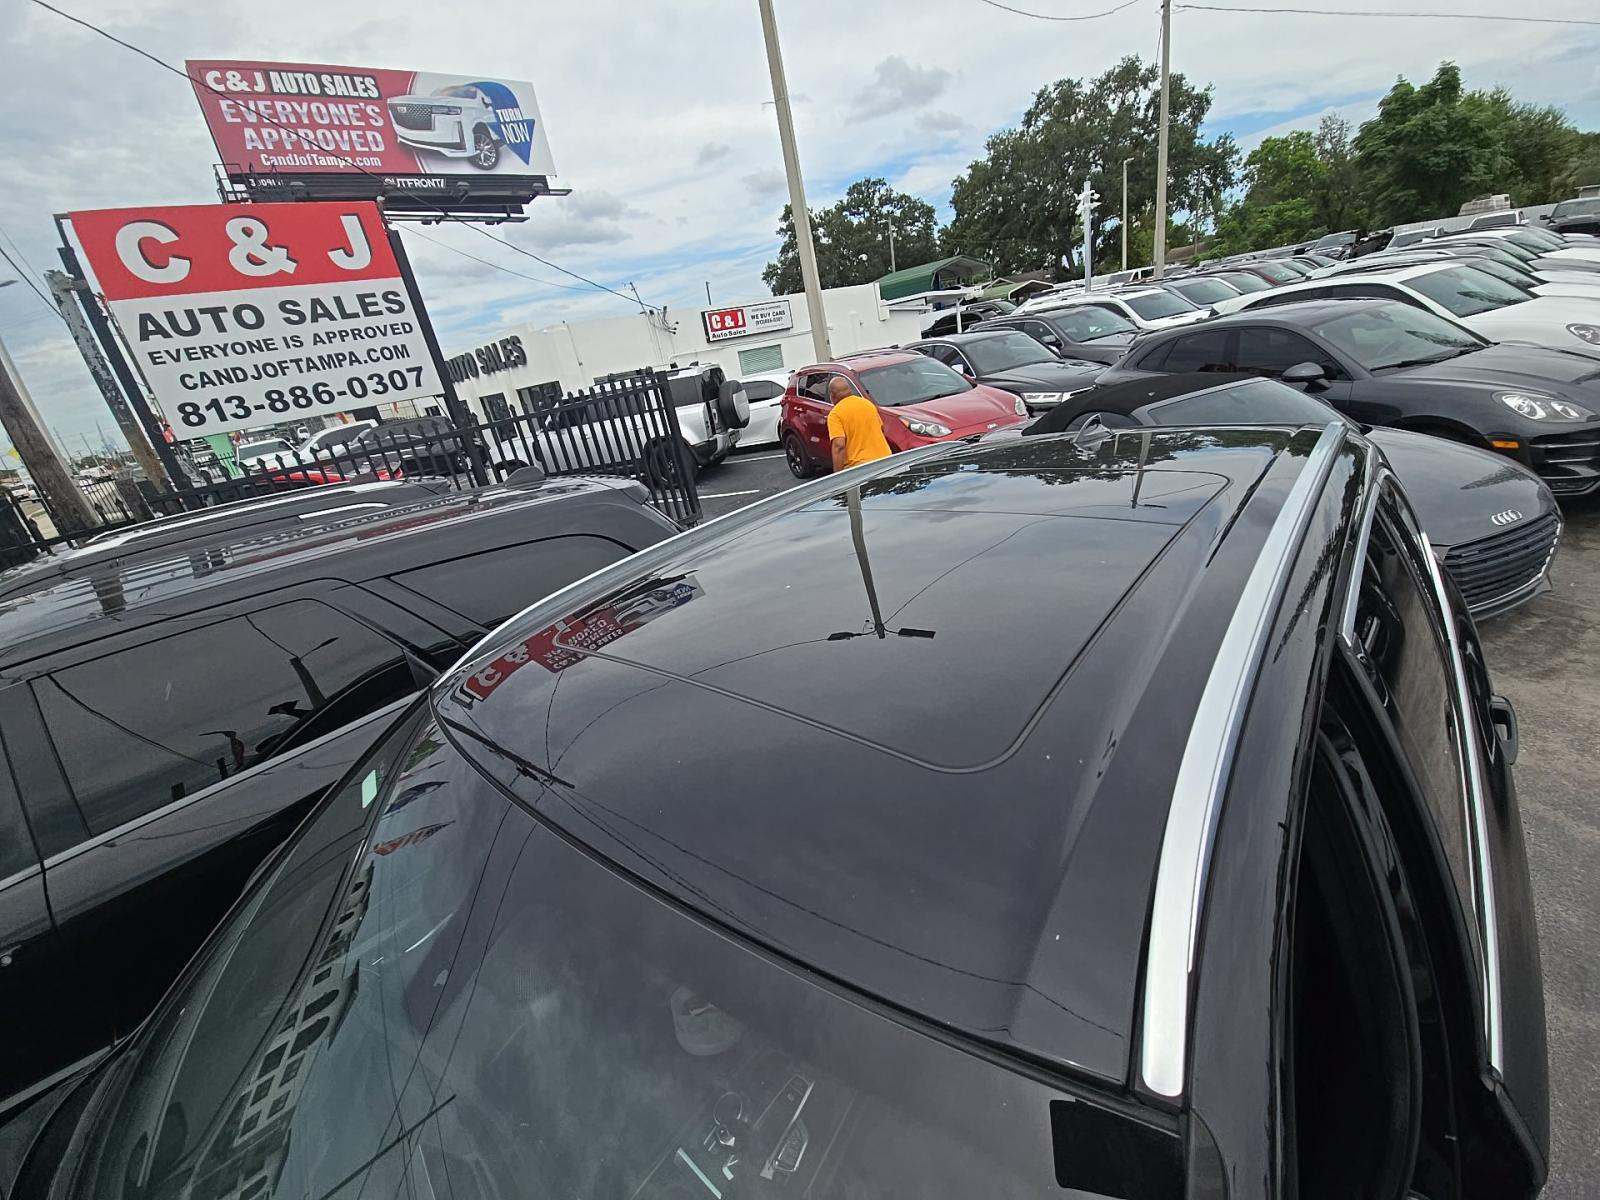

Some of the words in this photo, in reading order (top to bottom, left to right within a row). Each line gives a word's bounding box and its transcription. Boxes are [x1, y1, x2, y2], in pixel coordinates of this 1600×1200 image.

[269, 71, 321, 95] AUTO
[320, 73, 380, 98] SALES
[219, 99, 385, 127] EVERYONE'S
[243, 127, 385, 152] APPROVED
[501, 121, 531, 144] NOW
[261, 153, 382, 169] CandJofTampa.com
[115, 220, 192, 285] C
[225, 216, 298, 277] &
[328, 214, 373, 271] J
[138, 303, 266, 342] AUTO
[278, 290, 406, 326] SALES
[711, 314, 722, 329] C
[724, 315, 735, 328] &
[147, 337, 279, 366] EVERYONE
[283, 334, 305, 349] IS
[312, 321, 414, 346] APPROVED
[475, 335, 528, 375] SALES
[179, 343, 411, 391] CANDJOFTAMPA.COM
[177, 365, 424, 428] 813-886-0307
